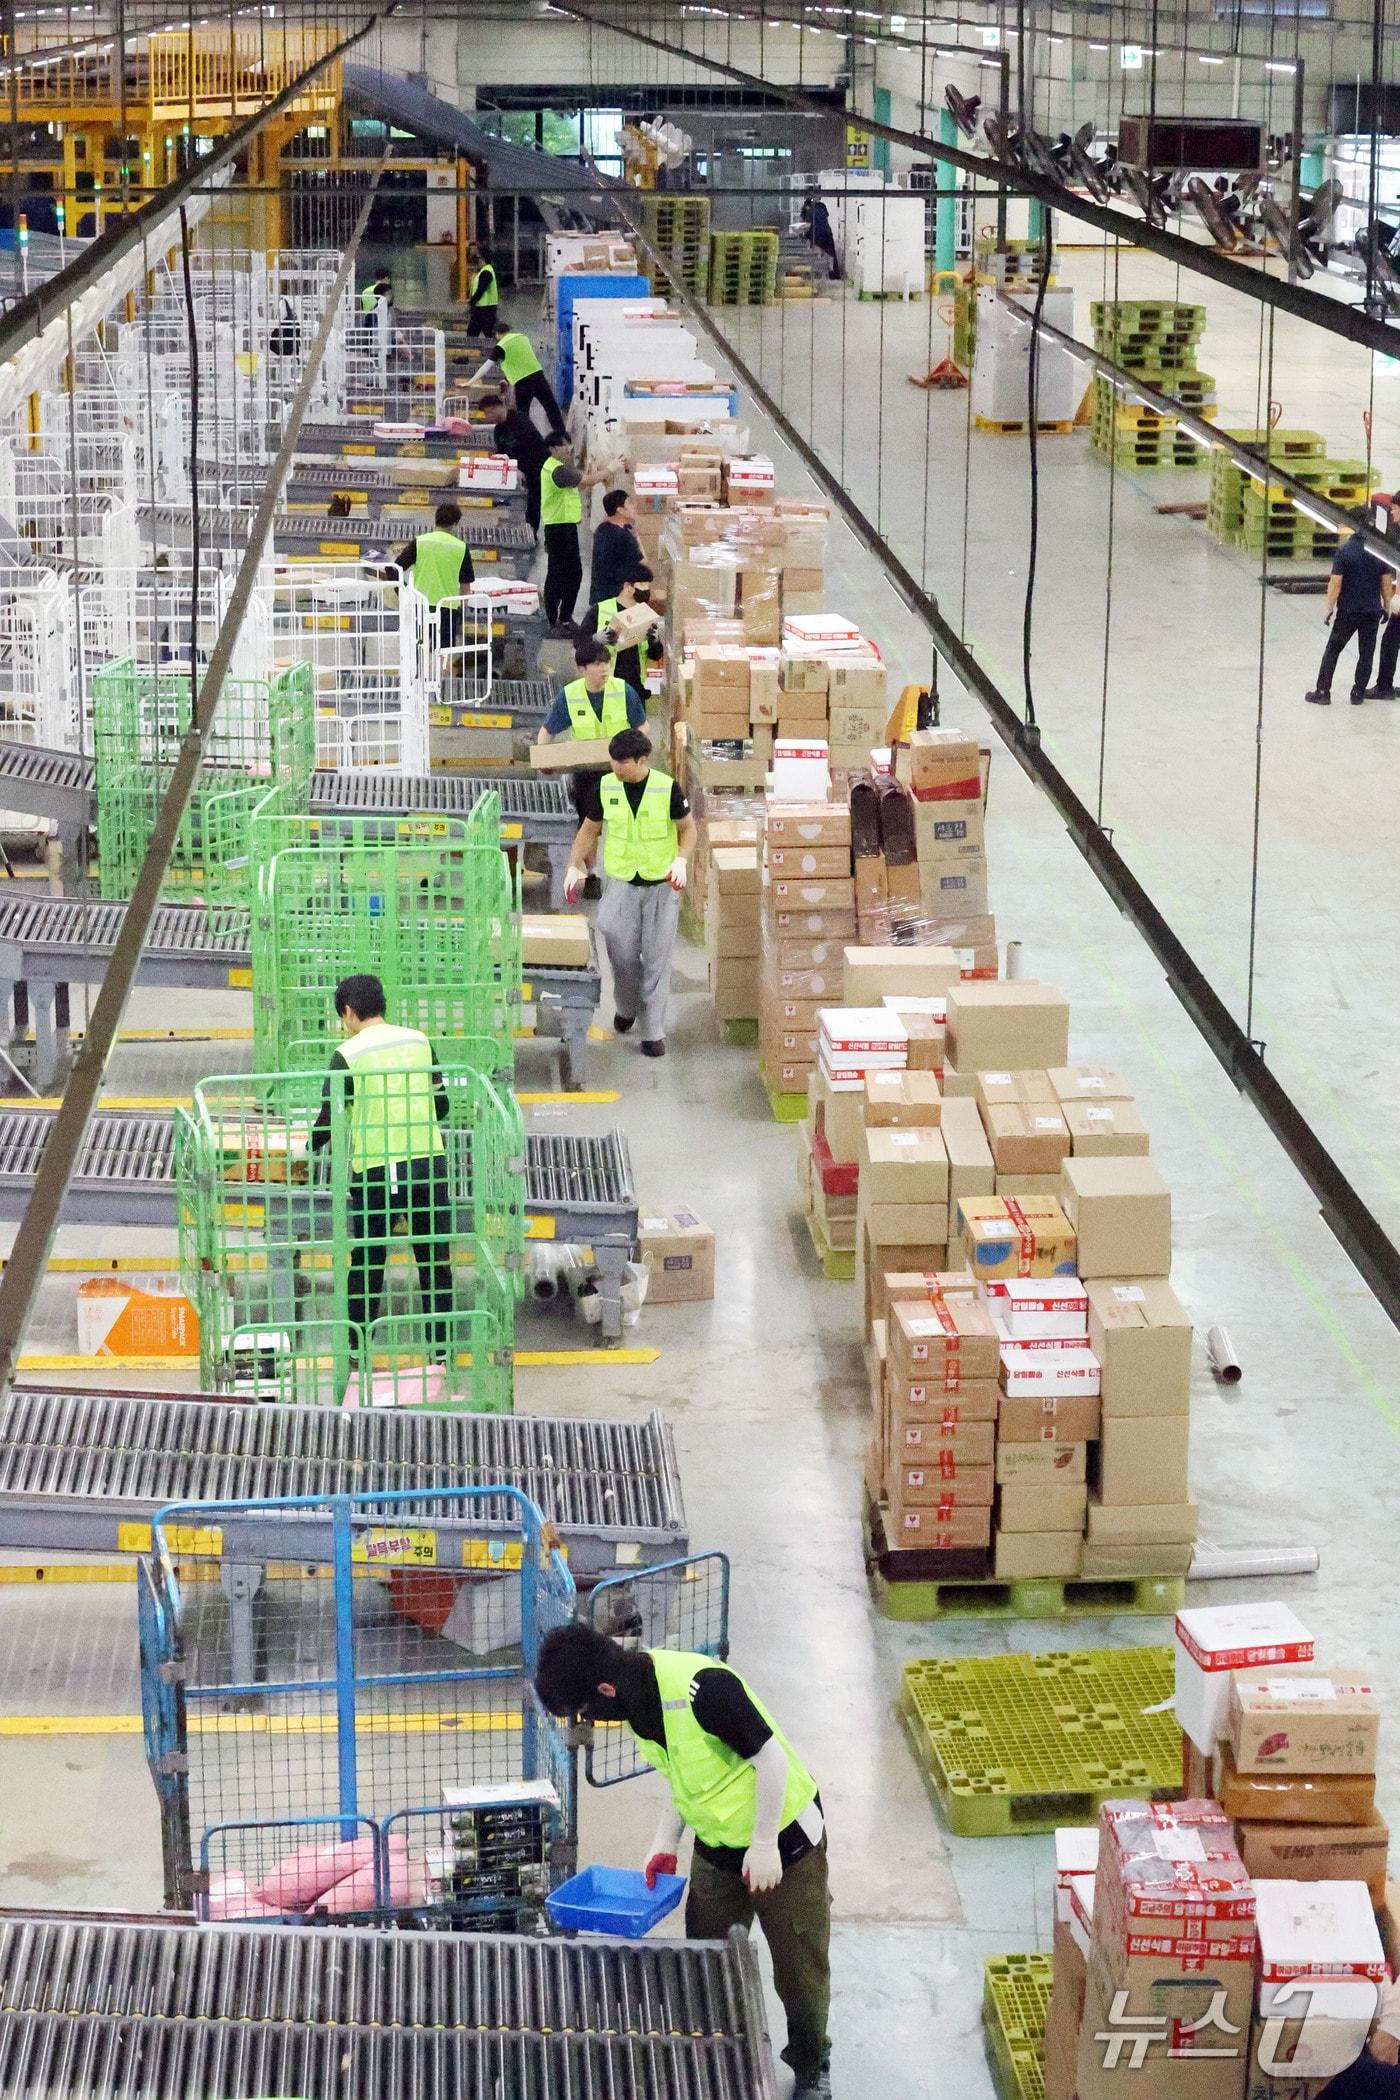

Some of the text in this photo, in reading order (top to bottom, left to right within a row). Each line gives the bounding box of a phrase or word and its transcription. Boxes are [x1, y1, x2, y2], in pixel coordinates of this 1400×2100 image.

[1012, 1302, 1045, 1311] 당일배송
[1013, 1371, 1043, 1379] 당일배송
[1056, 1369, 1085, 1378] 신선식품
[414, 1545, 434, 1558] 주의
[1142, 1903, 1171, 1914] 취급주의
[1130, 1938, 1172, 1953] 신선식품
